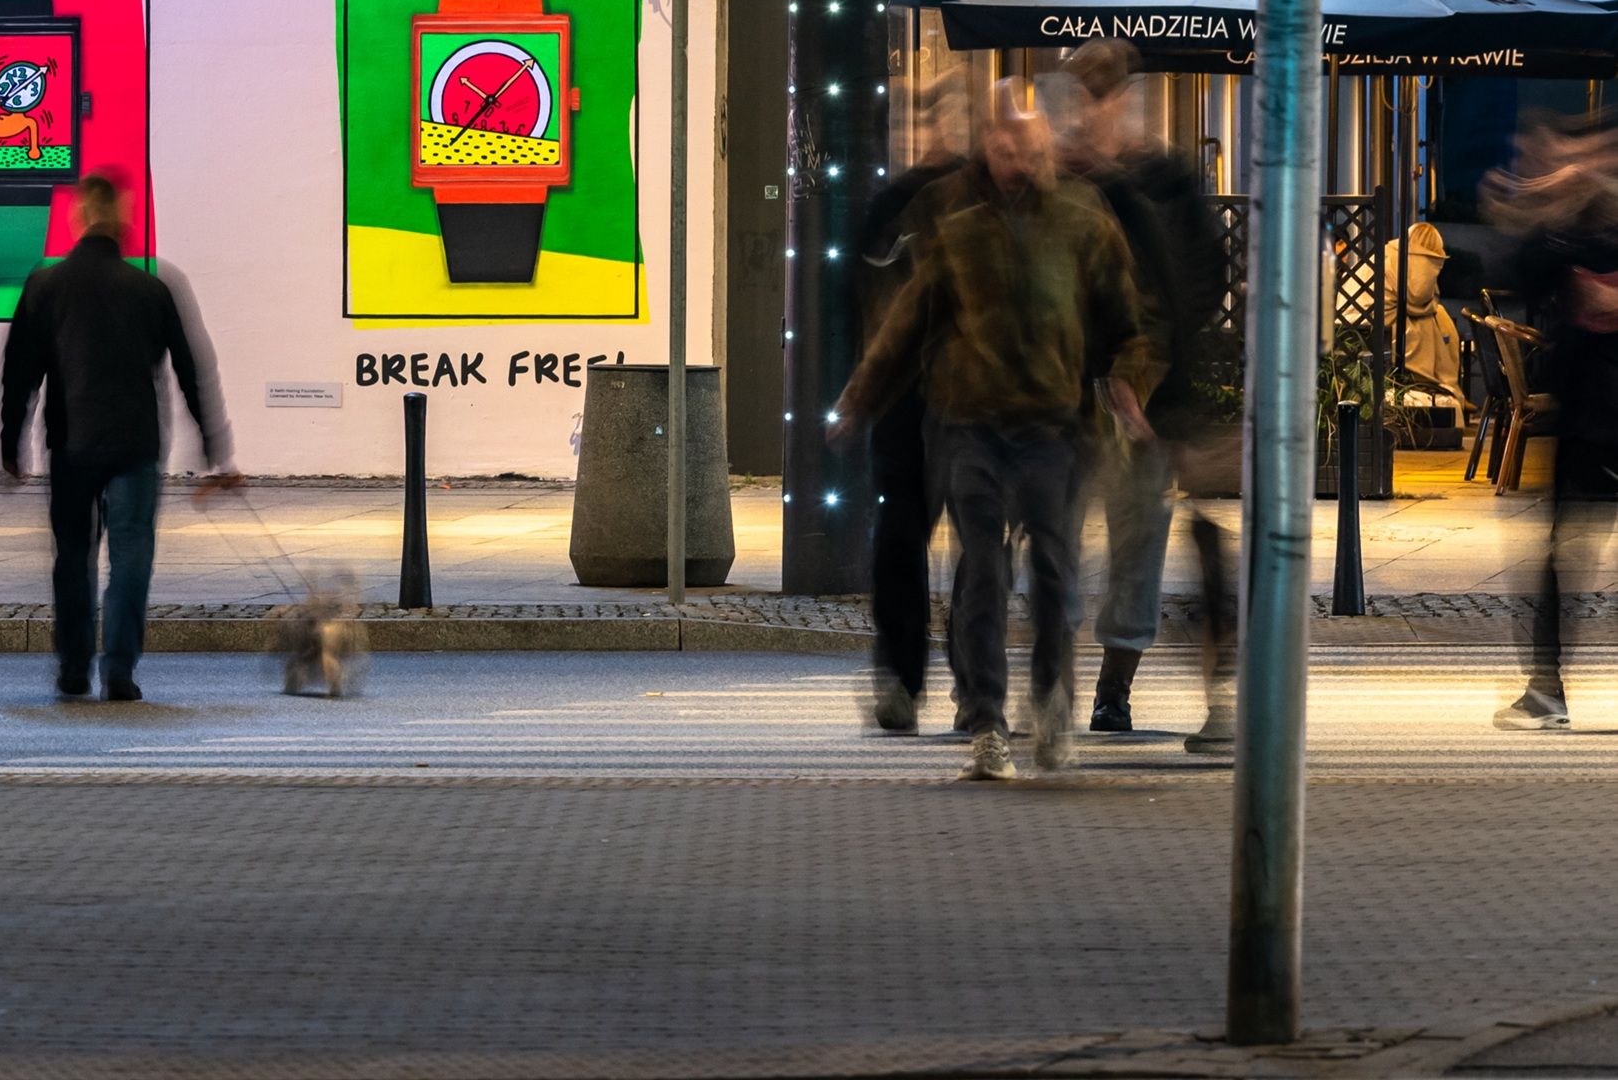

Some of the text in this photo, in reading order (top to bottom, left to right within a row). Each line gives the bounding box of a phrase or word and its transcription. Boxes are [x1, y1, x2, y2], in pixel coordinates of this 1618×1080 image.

[1040, 15, 1104, 38] CAŁA
[1113, 15, 1229, 39] NADZIEJA
[30, 81, 39, 97] 3
[12, 95, 22, 106] 6
[356, 350, 625, 388] BREAK FRE
